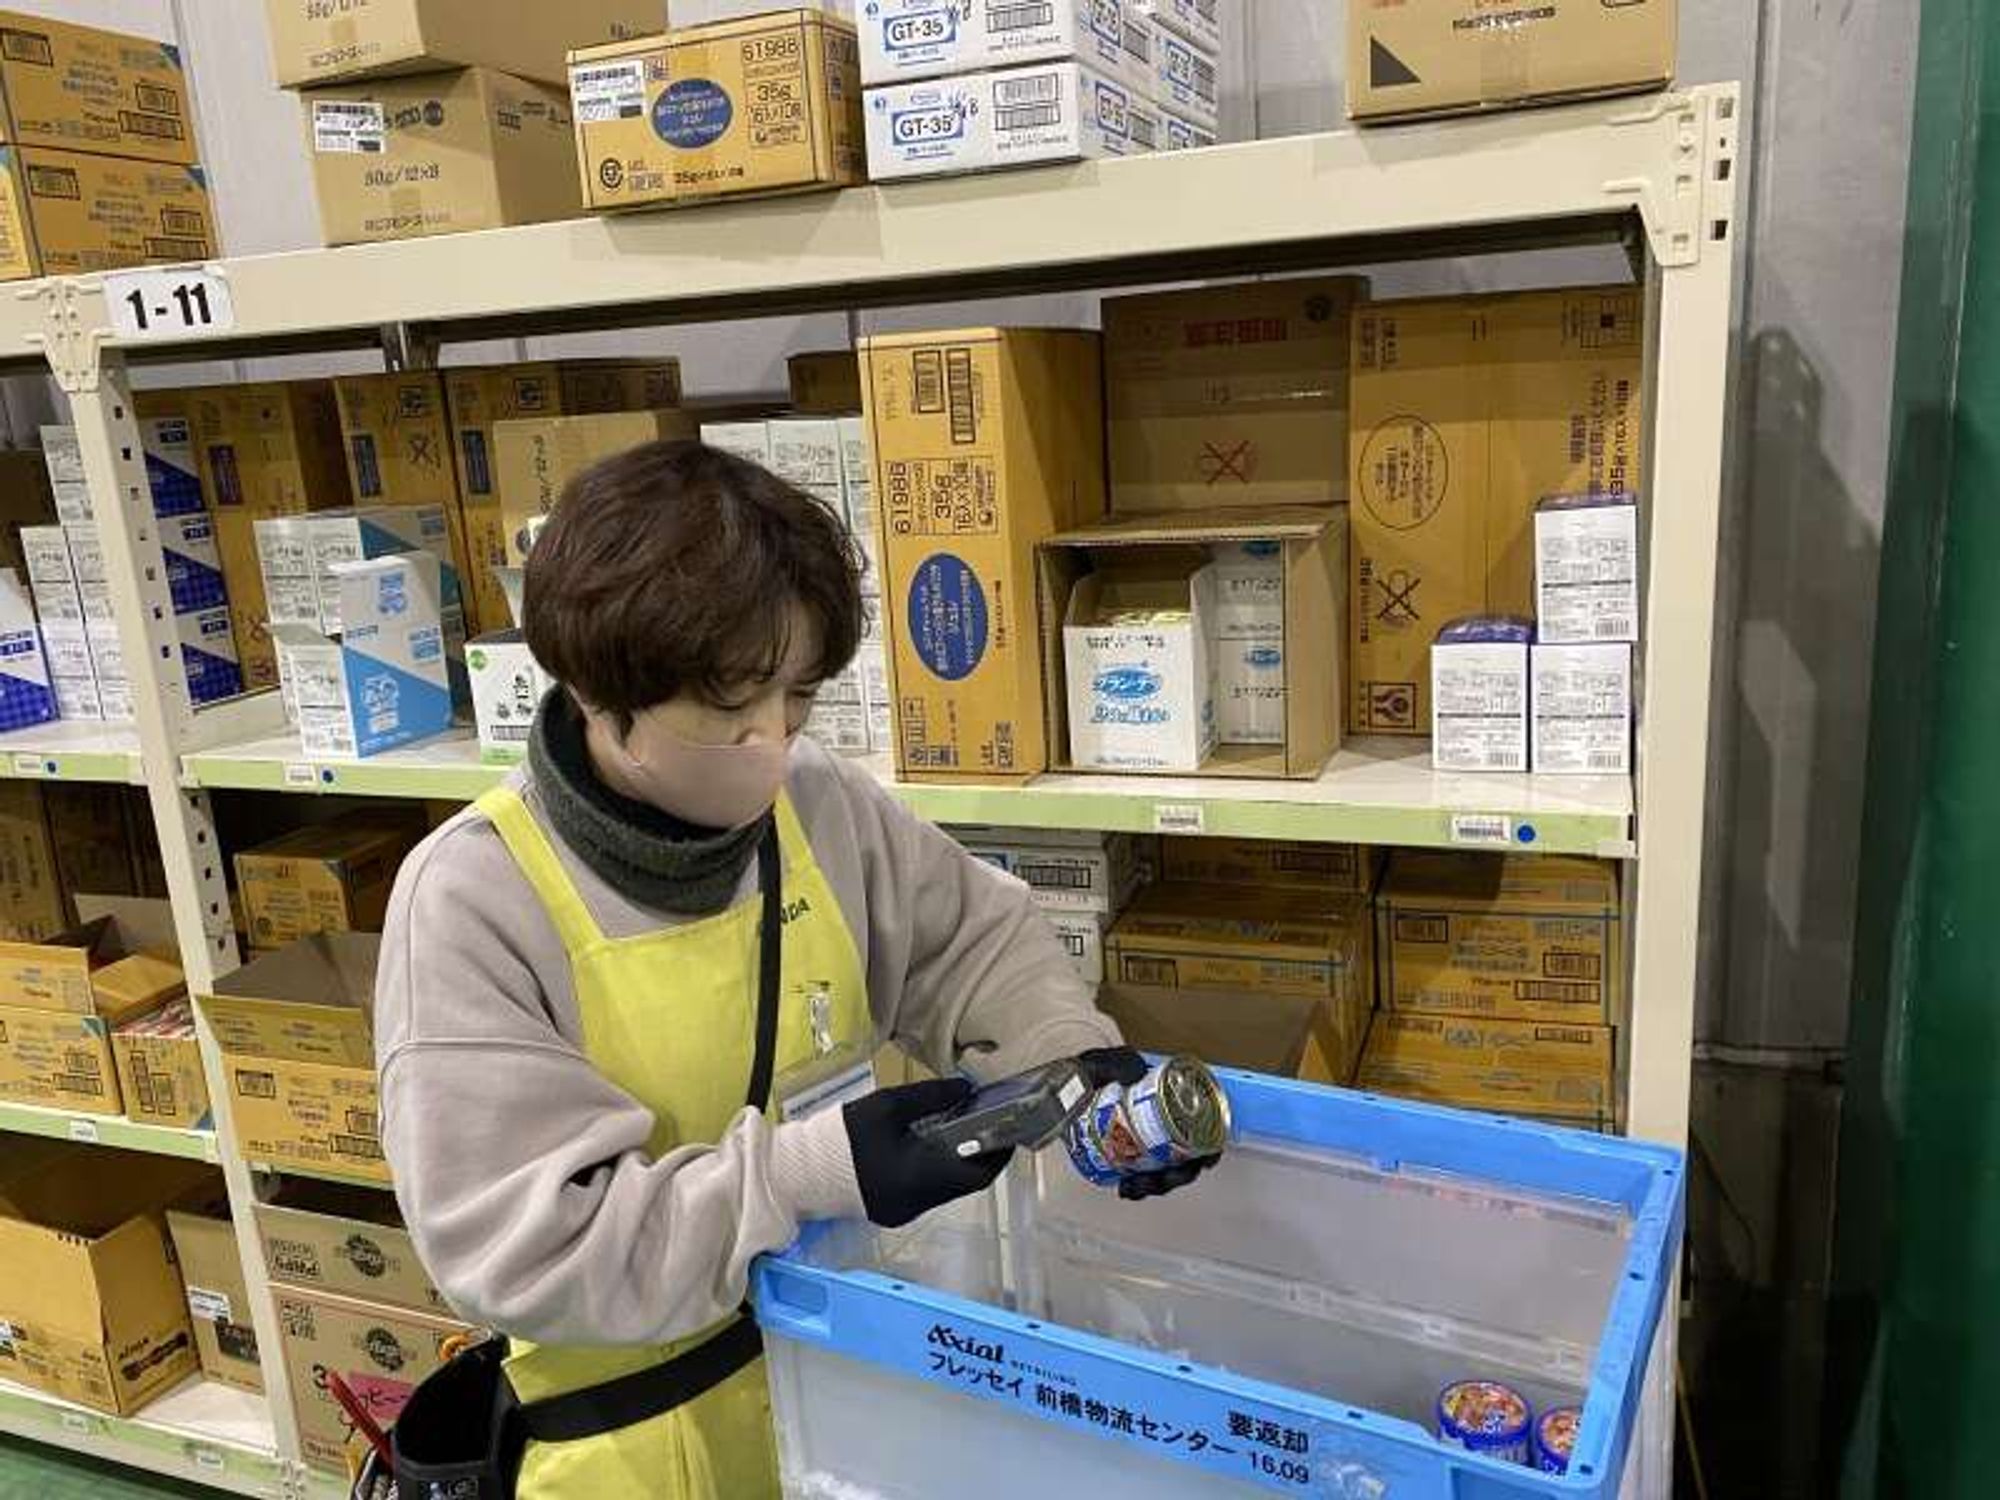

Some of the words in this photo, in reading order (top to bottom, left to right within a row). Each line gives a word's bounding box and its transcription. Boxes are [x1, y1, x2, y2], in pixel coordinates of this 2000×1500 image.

[892, 18, 944, 41] GT-35
[901, 117, 953, 139] GT-35
[125, 282, 212, 331] 1-11
[927, 1323, 1004, 1364] Axial
[929, 1352, 1025, 1398] フレッセイ
[1036, 1386, 1237, 1454] 前橋物流センター
[1227, 1409, 1310, 1455] 要返却
[1246, 1451, 1310, 1485] 16.09
